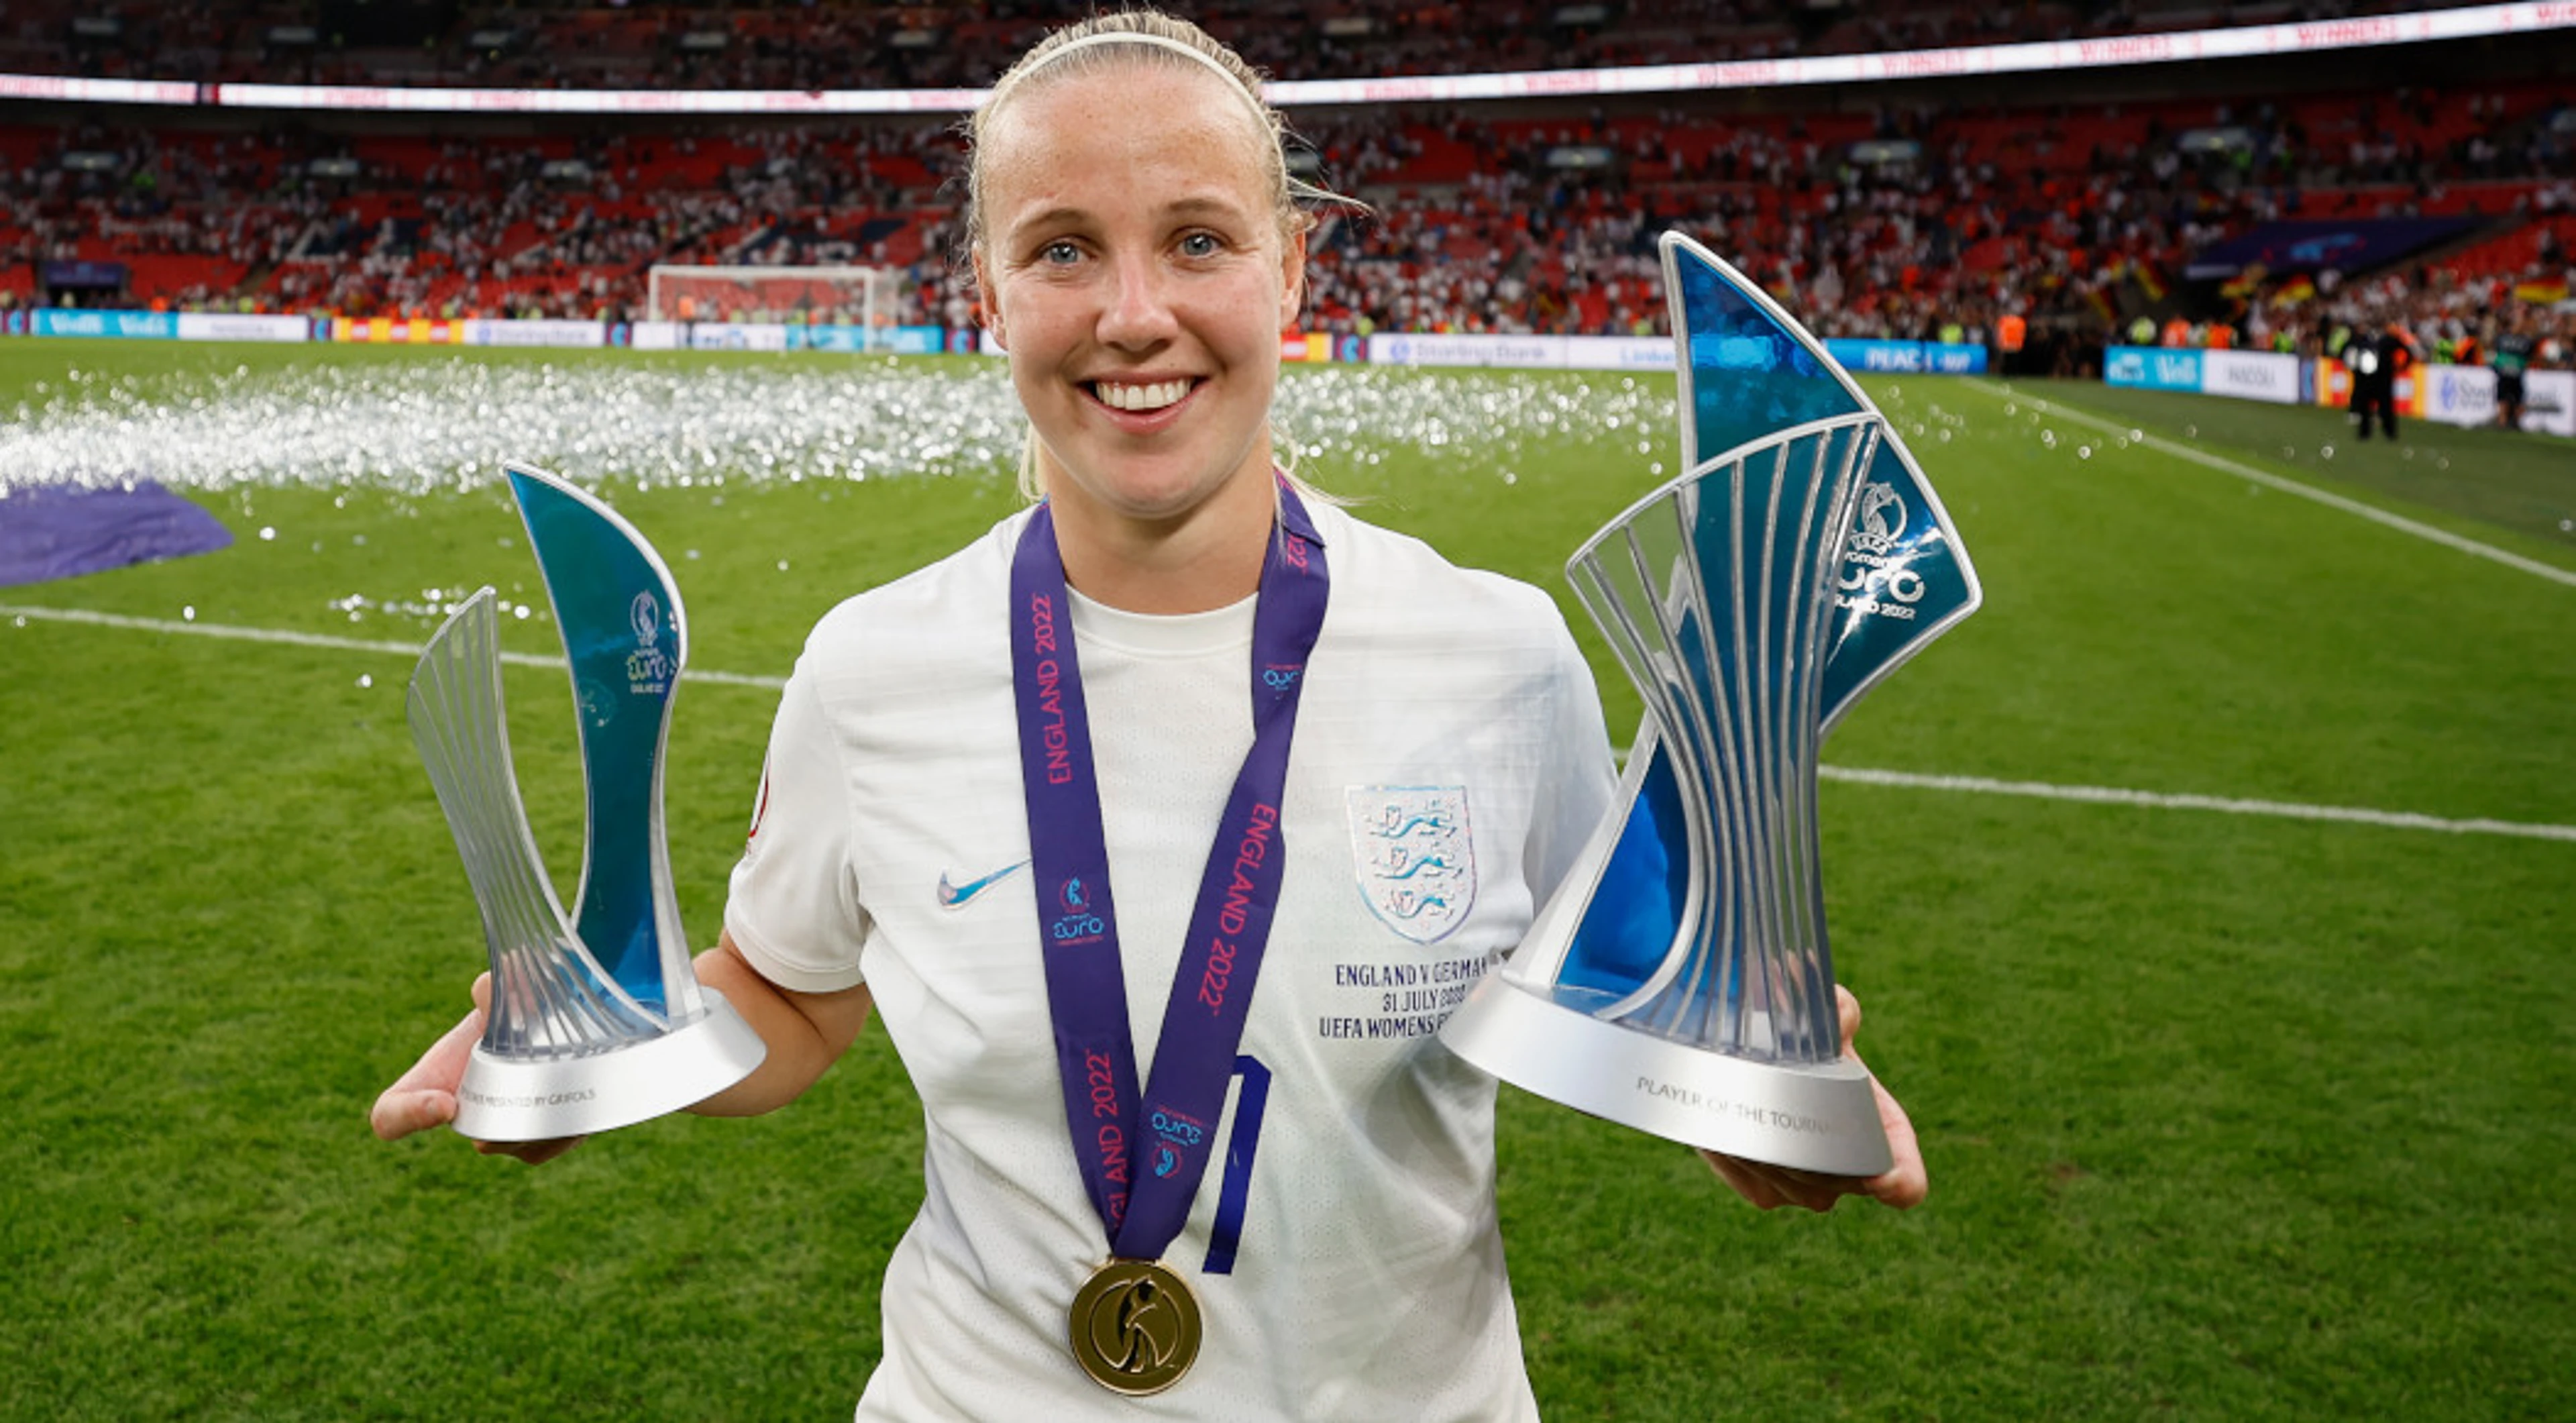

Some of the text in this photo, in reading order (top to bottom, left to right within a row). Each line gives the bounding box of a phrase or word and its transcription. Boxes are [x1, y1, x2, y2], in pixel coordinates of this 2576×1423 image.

[1032, 593, 1072, 785] ENGLAND 2022
[1198, 802, 1277, 1008] ENGLAND 2022
[1335, 964, 1416, 987] ENGLAND
[1383, 993, 1397, 1012] 31
[1402, 989, 1438, 1012] JULY
[1319, 1017, 1362, 1039] UEFA
[1366, 1013, 1434, 1039] WOMENS
[1085, 1052, 1119, 1118] 2022
[1637, 1077, 1701, 1107] PLAYER
